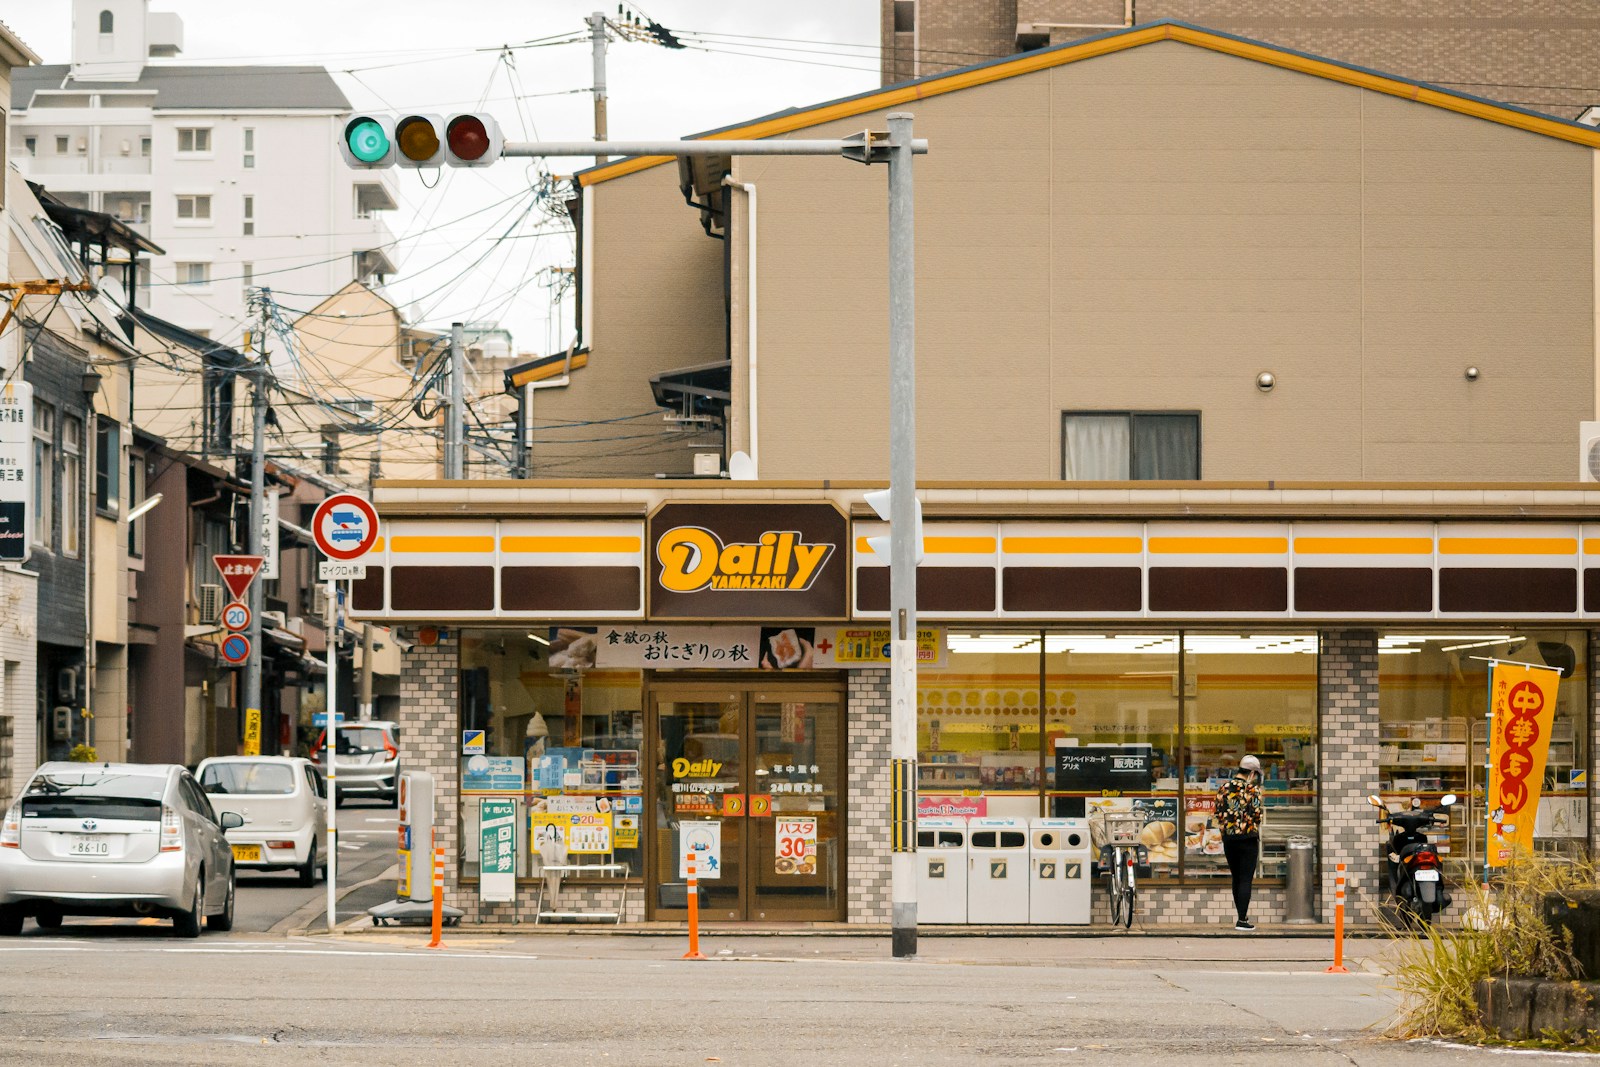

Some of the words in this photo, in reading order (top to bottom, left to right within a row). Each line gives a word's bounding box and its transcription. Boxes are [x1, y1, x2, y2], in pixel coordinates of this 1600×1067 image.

[657, 526, 831, 592] Daily
[223, 563, 254, 575] 止まれ
[321, 566, 364, 576] マイクロを除く
[711, 575, 786, 589] YAMAZAKI
[228, 610, 245, 624] 20
[606, 629, 669, 645] 食欲の秋
[644, 643, 750, 662] おにぎりの秋
[1501, 683, 1542, 811] 中華まん
[671, 757, 723, 778] Daily
[773, 764, 820, 774] 年中無休
[1113, 758, 1144, 769] 販売中
[769, 783, 824, 794] 24時間営業
[1101, 789, 1121, 798] Daily
[493, 806, 513, 814] 市バス
[581, 815, 595, 824] 20
[779, 823, 814, 834] パスタ
[77, 842, 108, 853] 86-10
[497, 825, 512, 872] 回数券
[780, 837, 805, 857] 30
